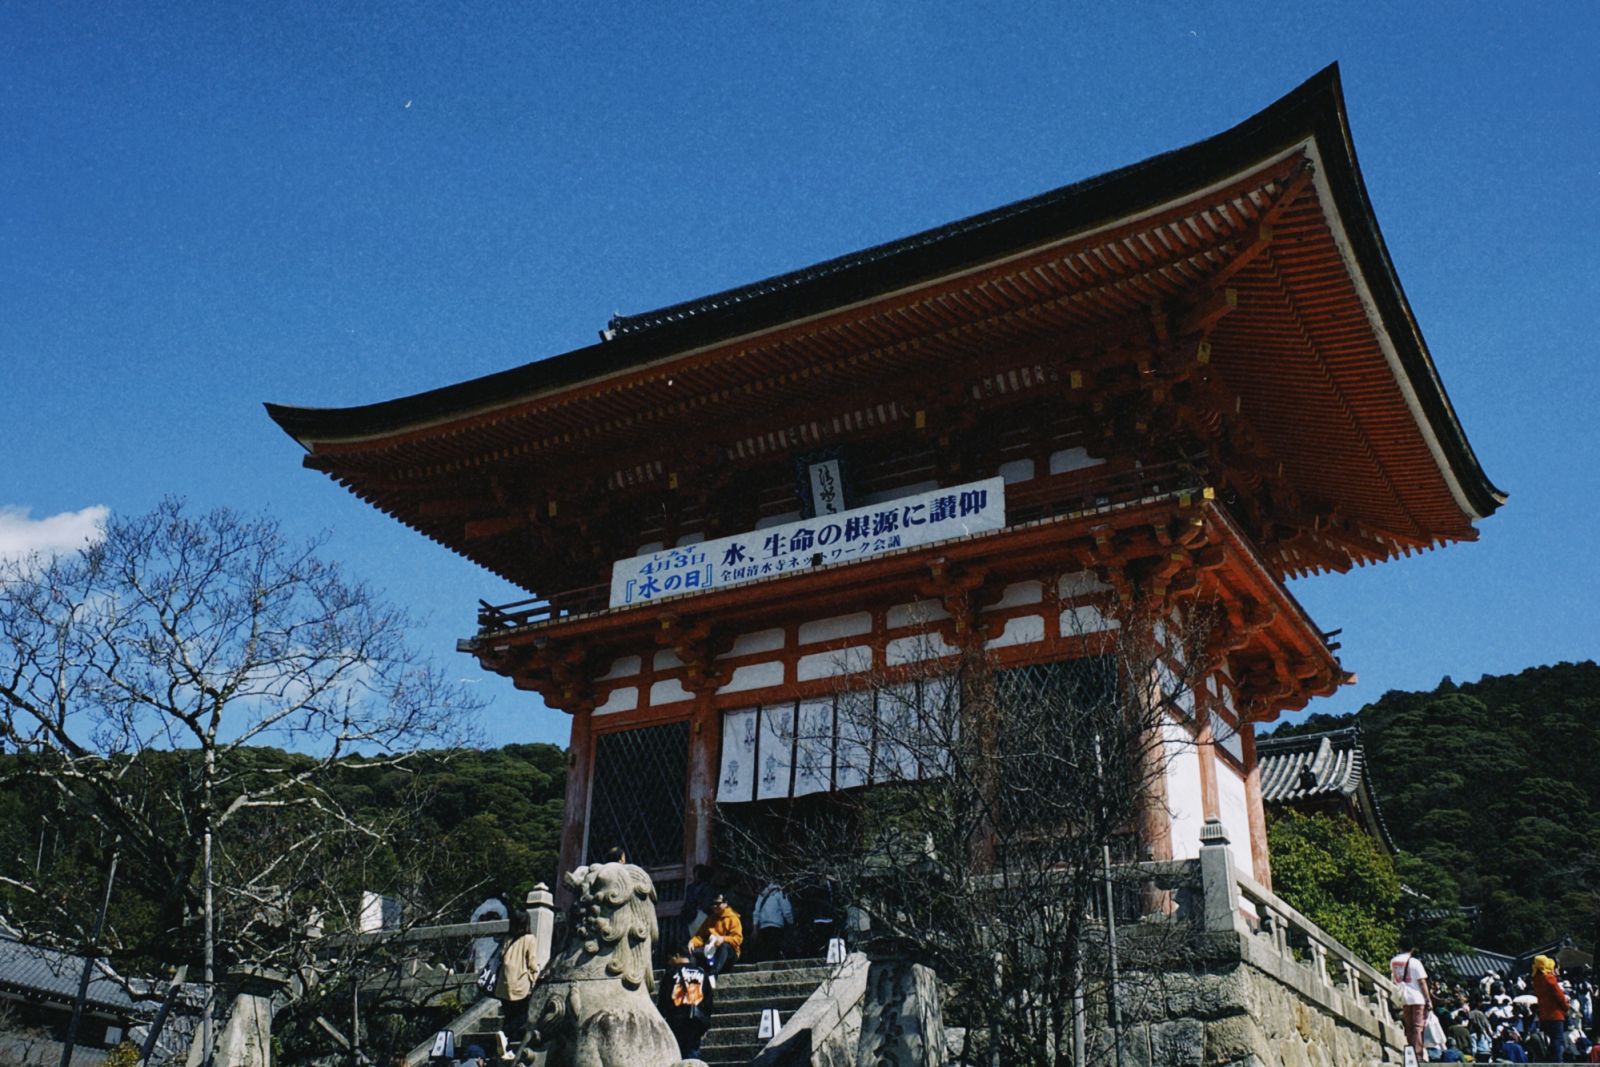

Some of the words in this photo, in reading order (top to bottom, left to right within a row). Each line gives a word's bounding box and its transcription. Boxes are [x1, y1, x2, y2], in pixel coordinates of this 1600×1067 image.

[639, 552, 706, 575] 4月3日
[625, 563, 713, 604] 『水の日』
